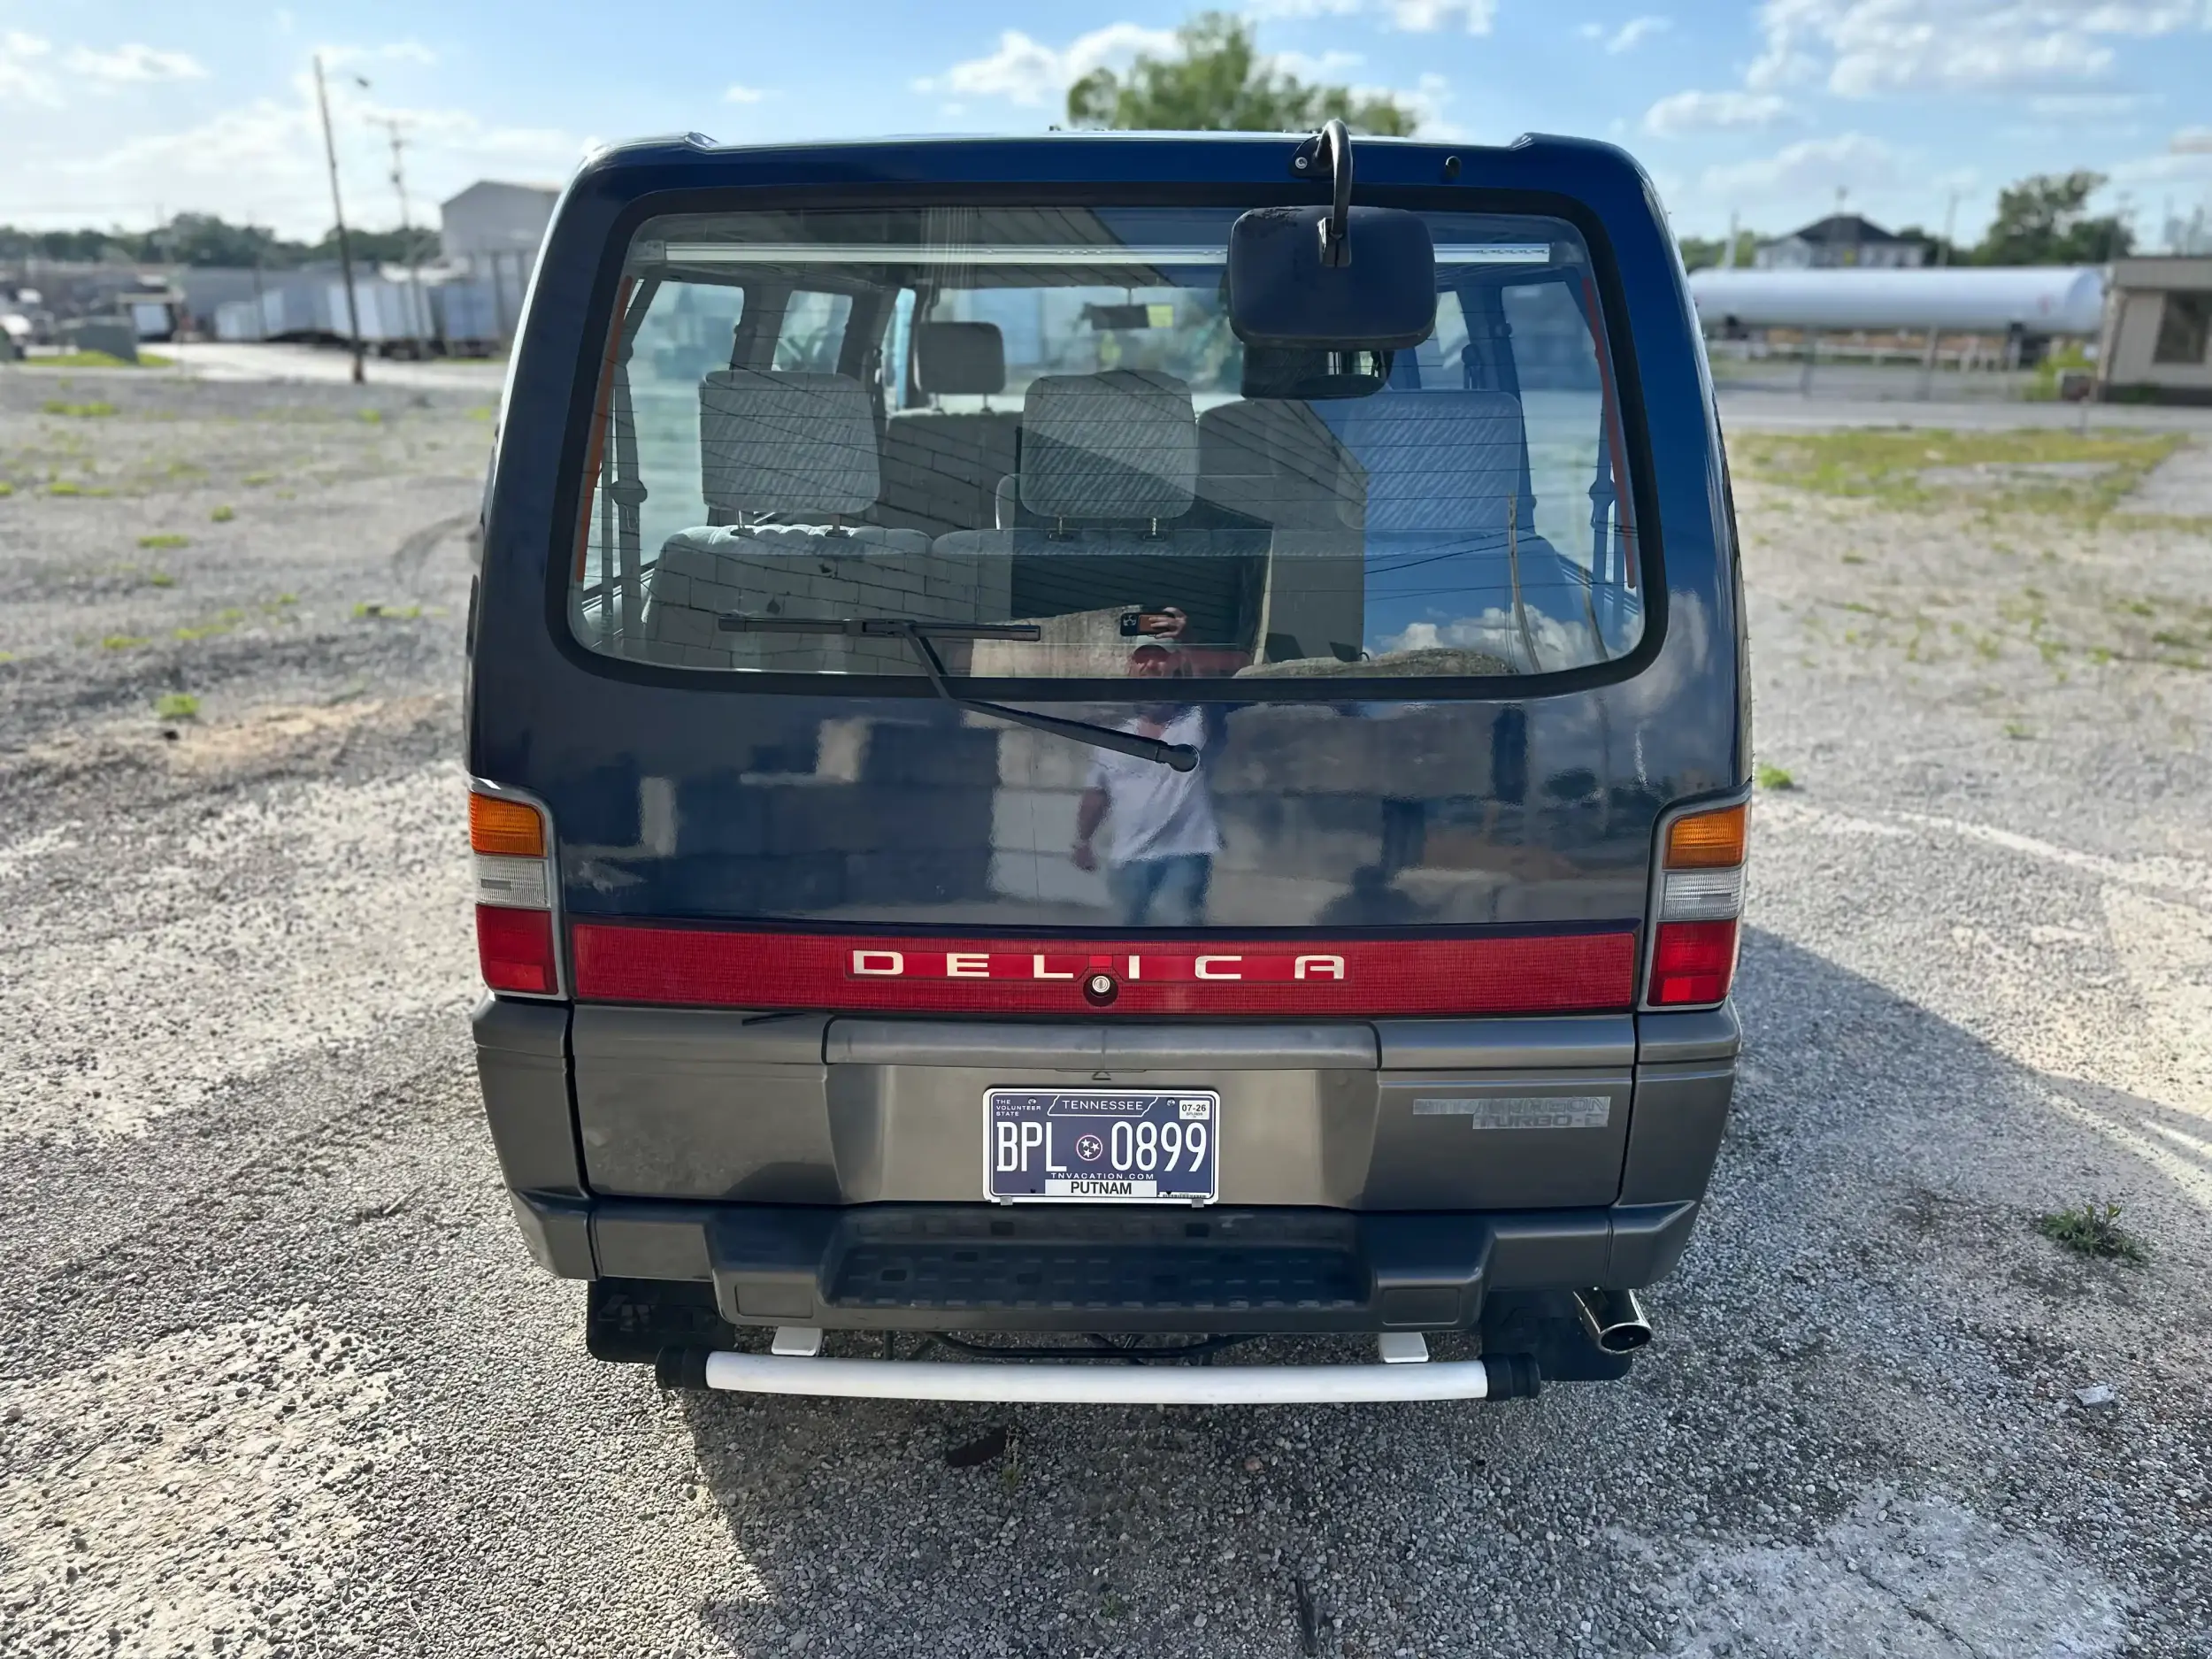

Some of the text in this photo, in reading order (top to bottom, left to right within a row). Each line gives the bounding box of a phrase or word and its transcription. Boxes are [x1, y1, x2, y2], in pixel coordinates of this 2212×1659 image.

[853, 949, 1345, 980] DELICA
[1062, 1100, 1144, 1110] TENNESSEE
[1181, 1103, 1207, 1112] 07-26
[996, 1120, 1207, 1172] BPL 0899
[1070, 1180, 1133, 1195] PUTNAM
